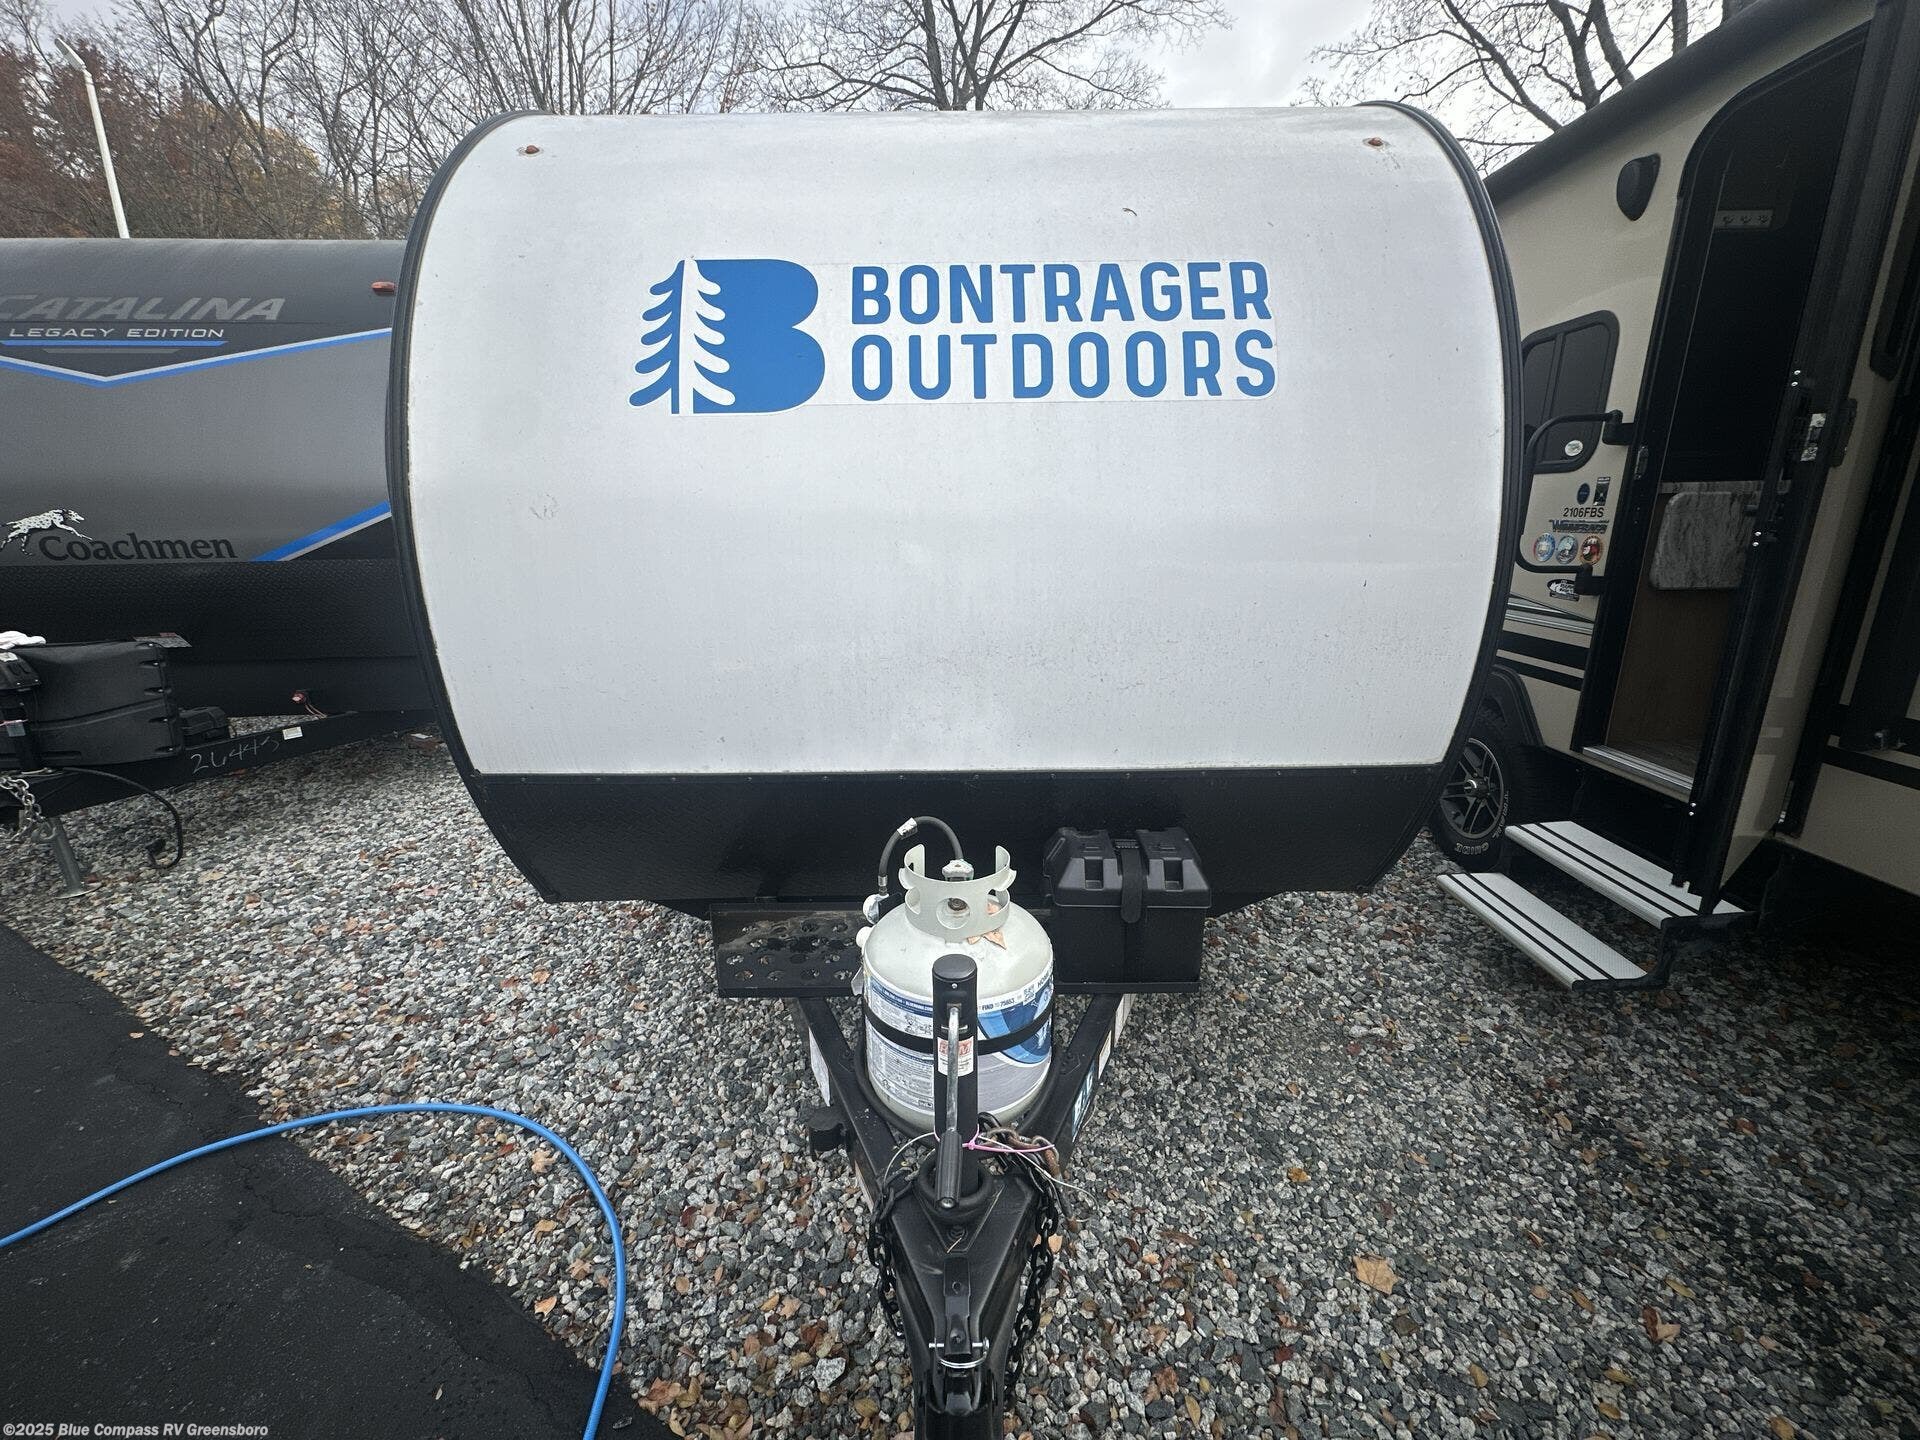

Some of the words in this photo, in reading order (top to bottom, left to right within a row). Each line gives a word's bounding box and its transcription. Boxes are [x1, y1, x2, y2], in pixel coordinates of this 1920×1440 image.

[851, 261, 1272, 324] BONTRAGER
[0, 294, 286, 321] CATALINA
[9, 328, 115, 338] LEGACY
[126, 328, 225, 338] EDITION
[851, 329, 1276, 401] OUTDOORS
[1562, 507, 1605, 518] 2106FBS
[38, 532, 238, 561] Coachmen
